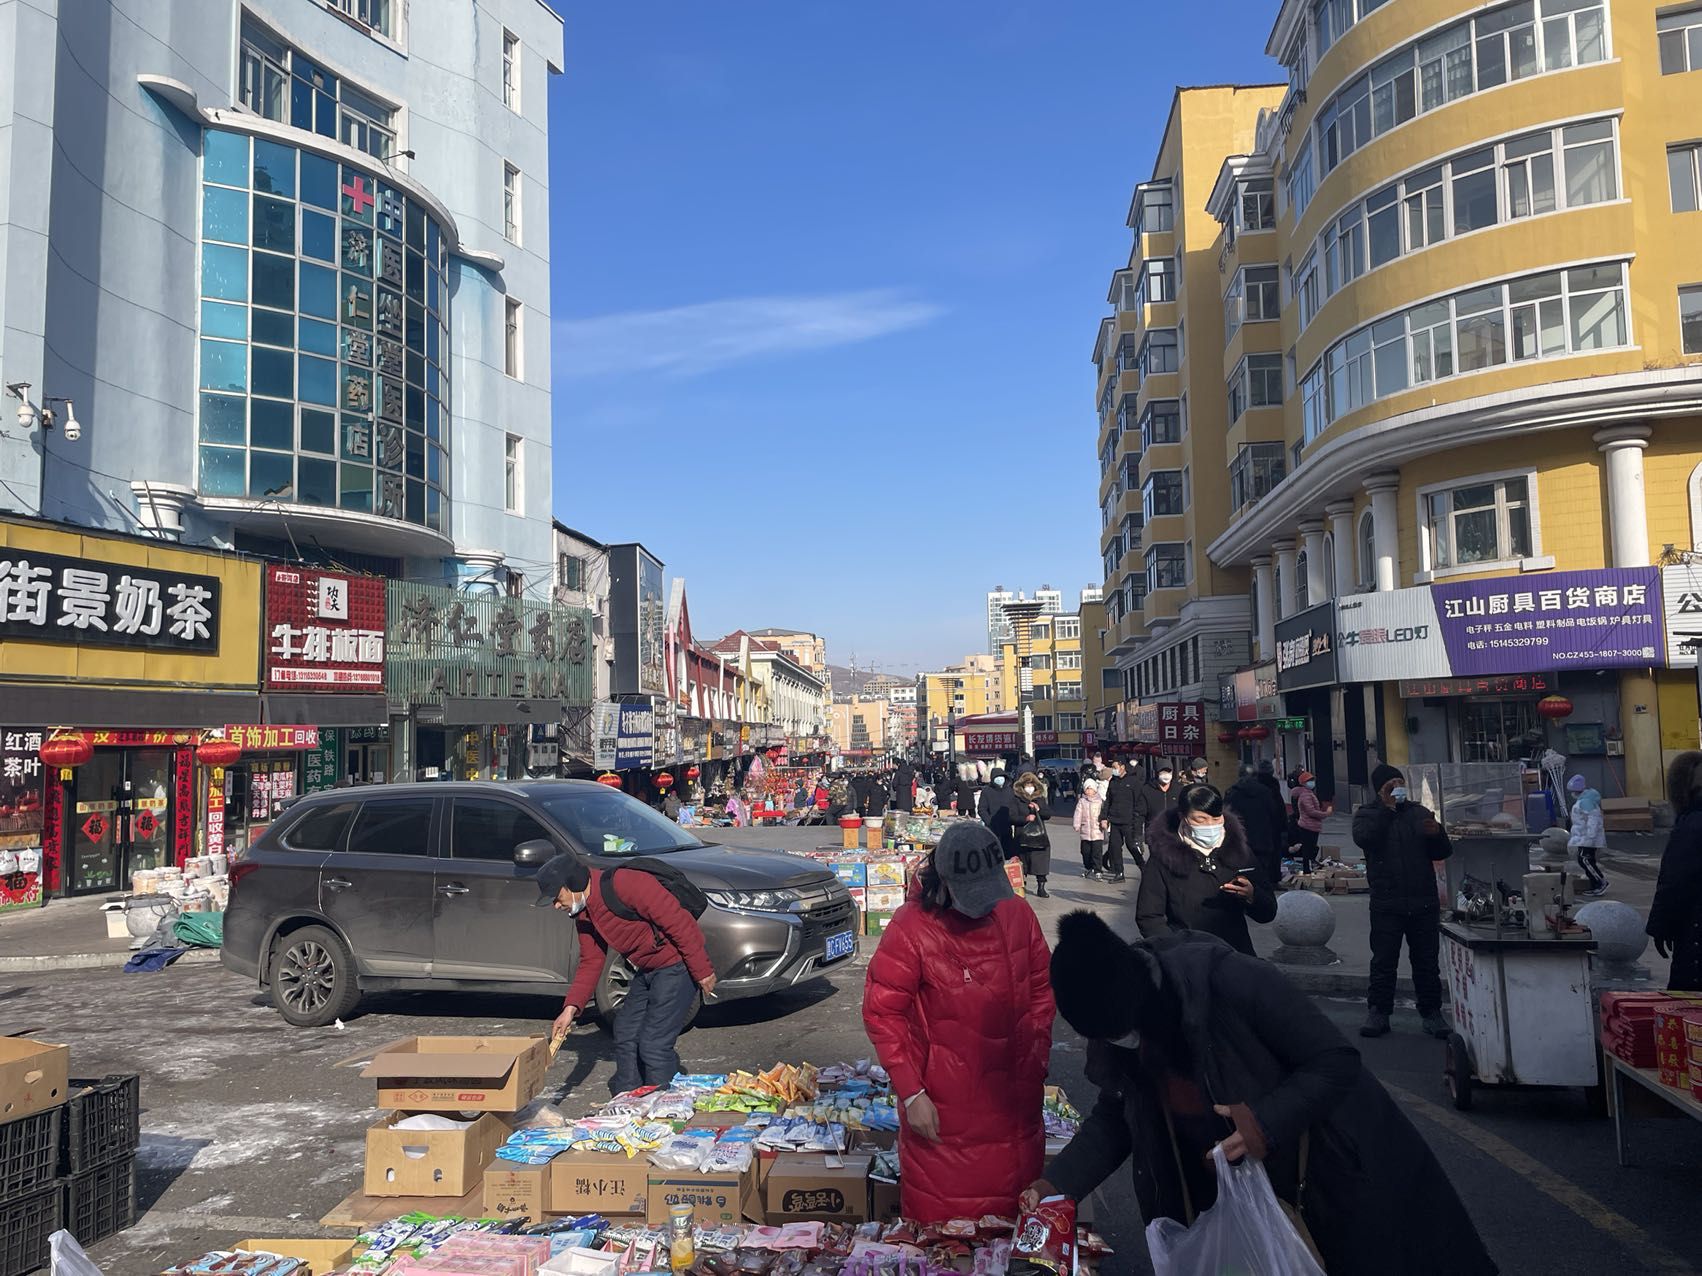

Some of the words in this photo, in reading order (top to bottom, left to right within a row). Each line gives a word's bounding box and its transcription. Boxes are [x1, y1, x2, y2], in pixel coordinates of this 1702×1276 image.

[0, 560, 213, 640] 街景奶茶
[1445, 584, 1647, 618] 江山厨具百货商店
[1466, 624, 1492, 635] 电子秤
[1494, 622, 1513, 633] 五金
[1514, 621, 1533, 632] 电料
[1536, 618, 1575, 630] 塑料制品
[1576, 616, 1607, 627] 电饭锅
[271, 623, 385, 663] 牛排板面
[1490, 637, 1549, 648] 15145329799
[429, 668, 569, 698] АПТЕКА
[1162, 705, 1199, 721] 厨具
[5, 732, 42, 751] 红酒
[1164, 725, 1200, 740] 日杂
[4, 757, 42, 777] 茶叶
[575, 1177, 626, 1196] 汪小糯
